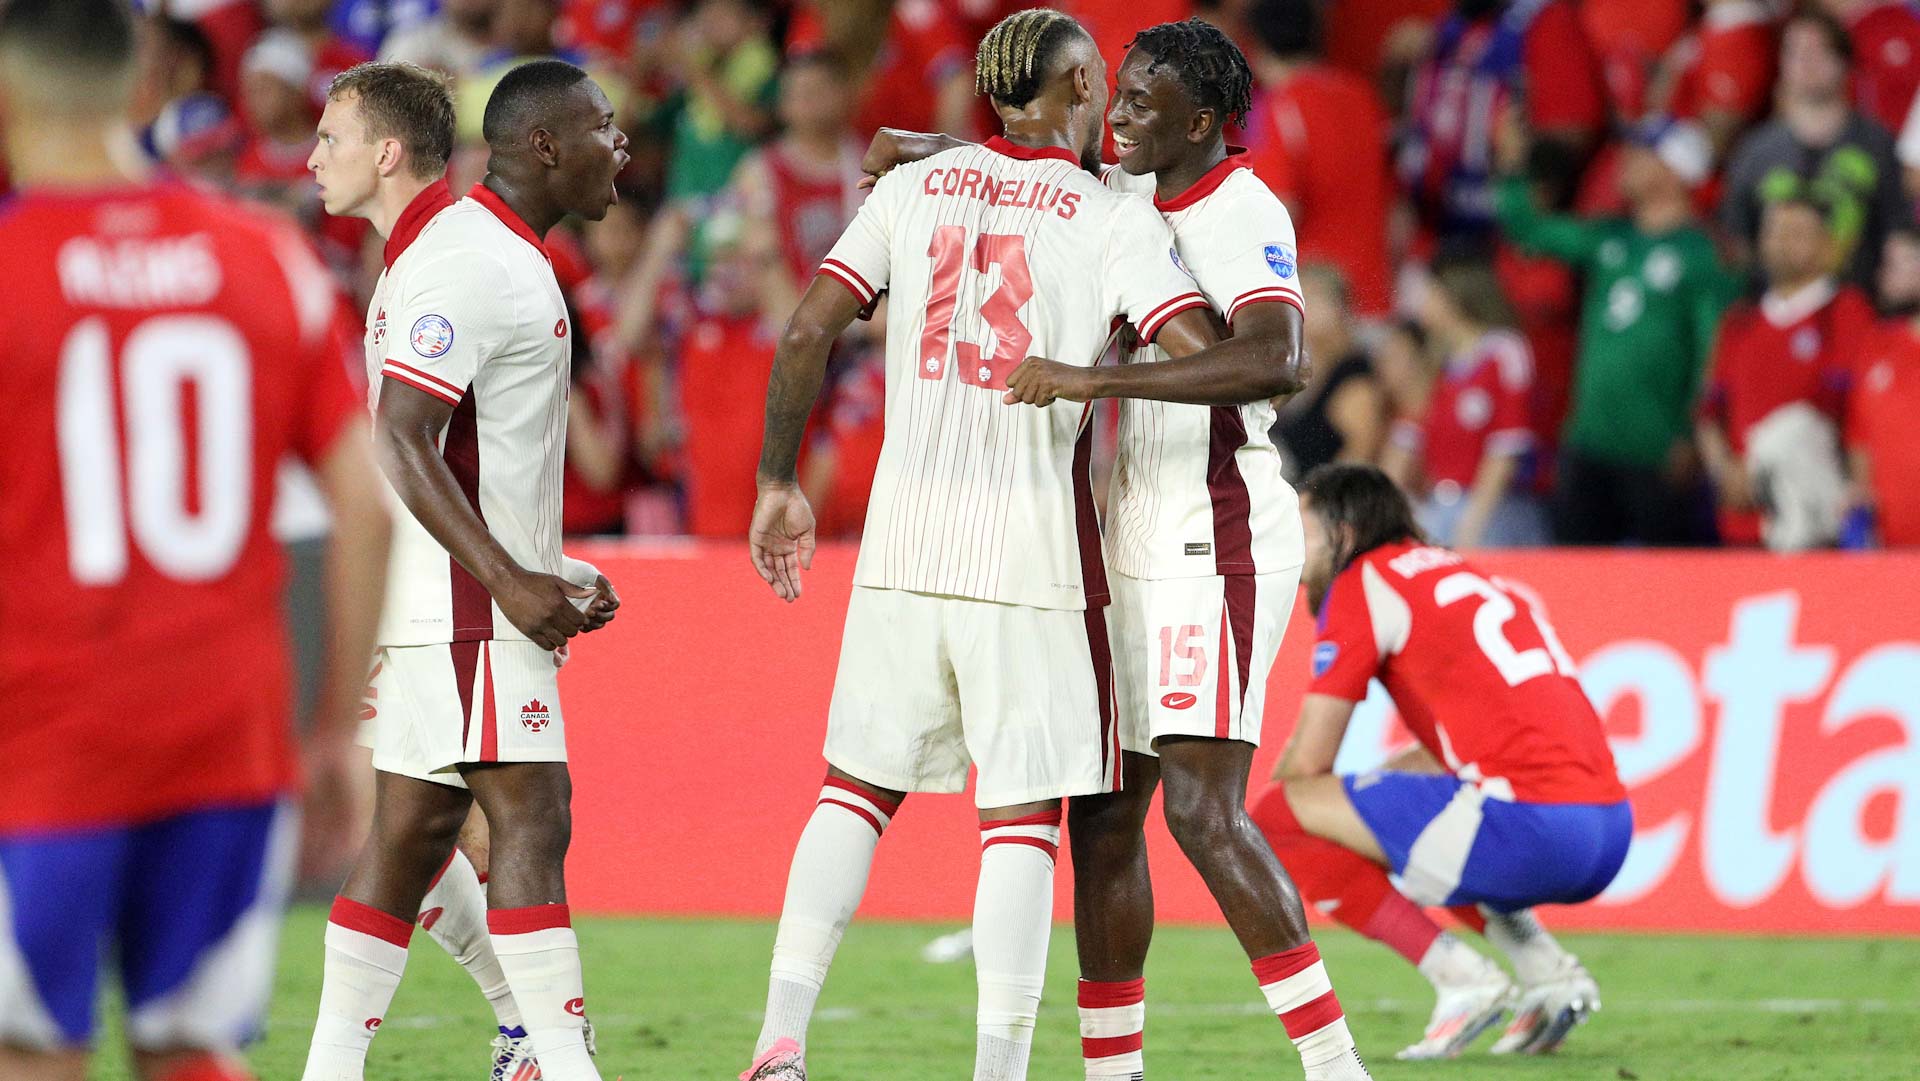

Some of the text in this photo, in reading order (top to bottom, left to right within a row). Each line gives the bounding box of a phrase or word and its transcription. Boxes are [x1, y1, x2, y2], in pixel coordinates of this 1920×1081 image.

[924, 167, 1082, 220] CORNELIUS
[918, 225, 1034, 392] 13
[56, 314, 254, 586] 10
[1159, 624, 1208, 687] 15
[1333, 588, 1920, 909] eta
